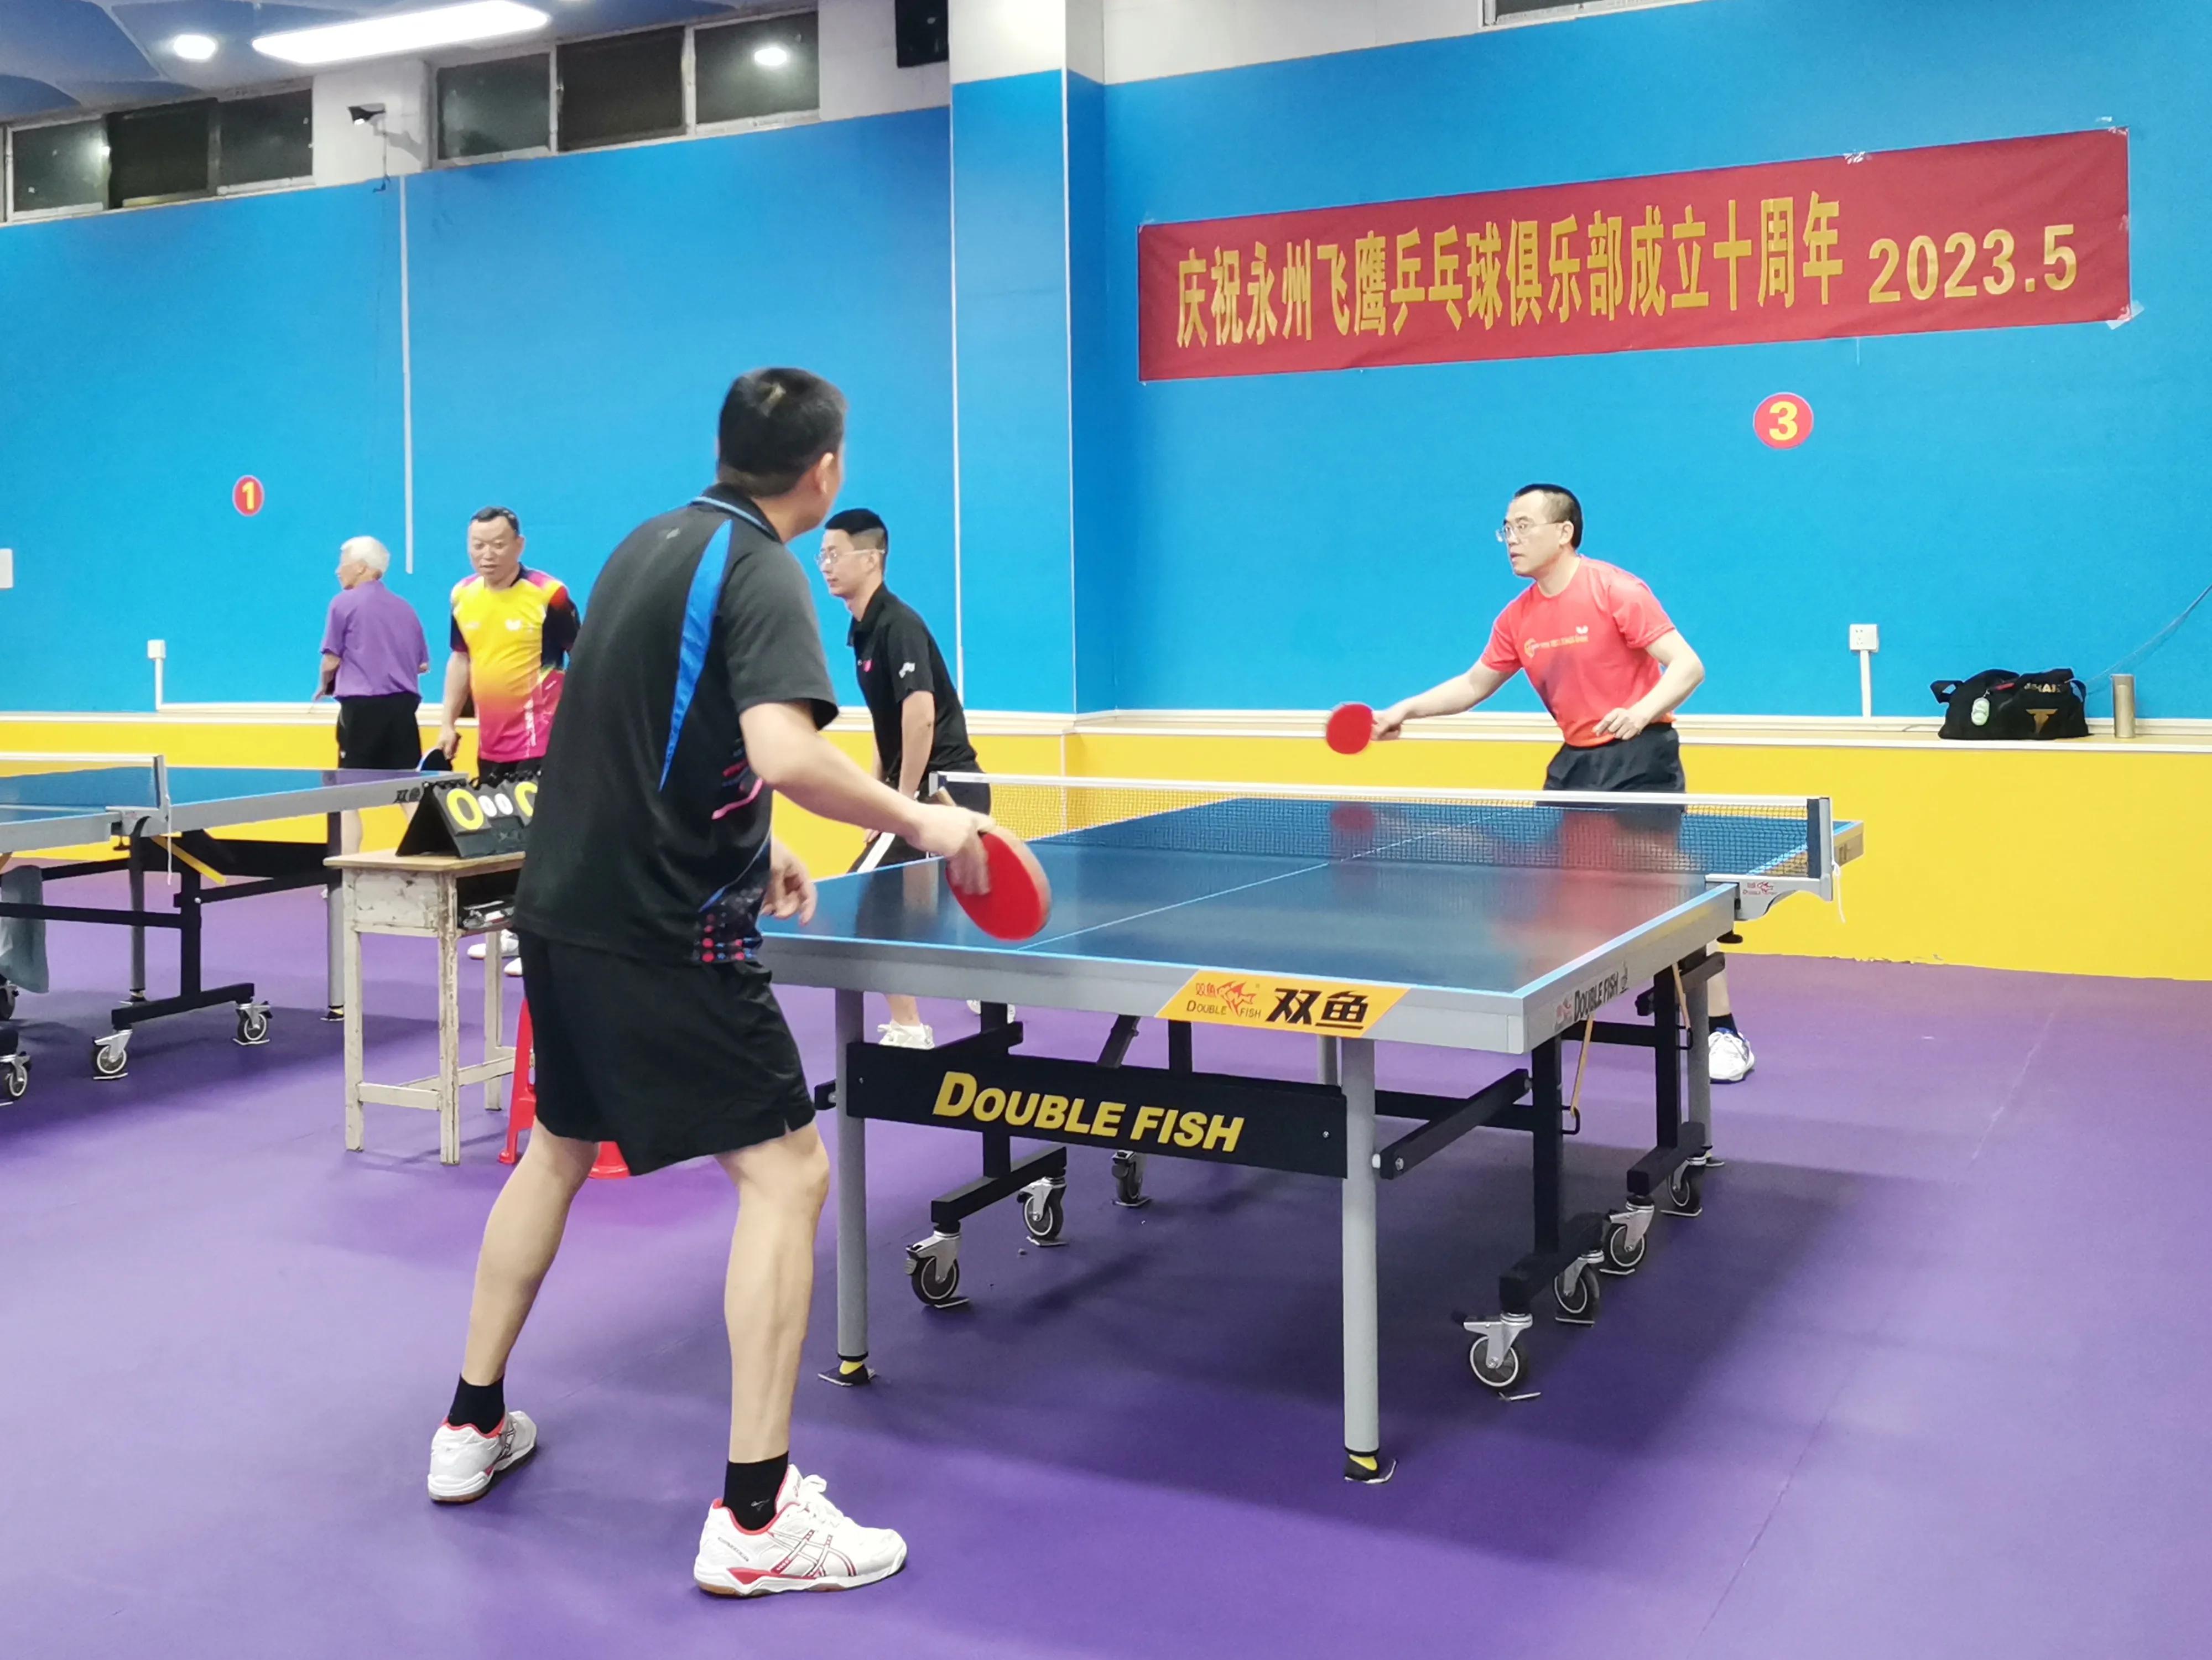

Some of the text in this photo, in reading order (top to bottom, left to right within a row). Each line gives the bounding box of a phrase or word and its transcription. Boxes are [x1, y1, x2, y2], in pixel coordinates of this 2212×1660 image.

[1177, 190, 2077, 347] 庆祝永州飞鹰乒乓球俱乐部成立十周年 2023.5
[1769, 401, 1798, 441] 3
[242, 481, 255, 511] 1
[1186, 1000, 1262, 1018] DOUBLE FISH
[1265, 987, 1369, 1030] 双鱼
[932, 1071, 1245, 1153] DOUBLE FISH
